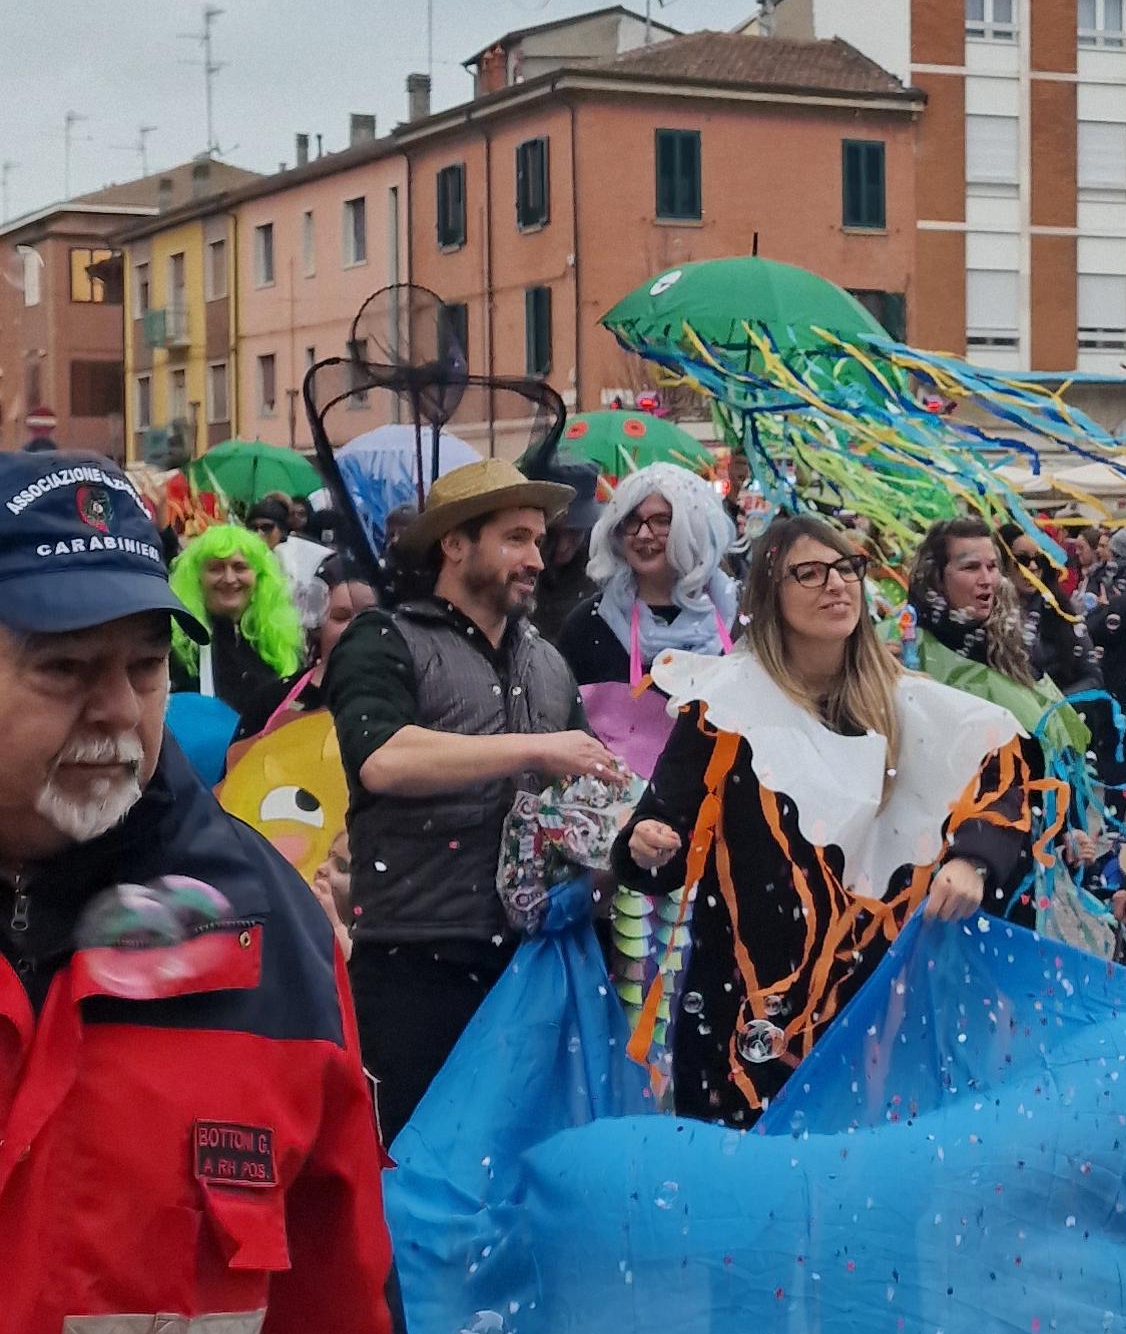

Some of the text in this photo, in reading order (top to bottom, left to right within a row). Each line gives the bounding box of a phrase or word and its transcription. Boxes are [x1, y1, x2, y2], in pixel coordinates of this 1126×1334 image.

[5, 467, 102, 516] ASSOCIAZIONE
[203, 1157, 213, 1174] A
[218, 1158, 236, 1176] RH
